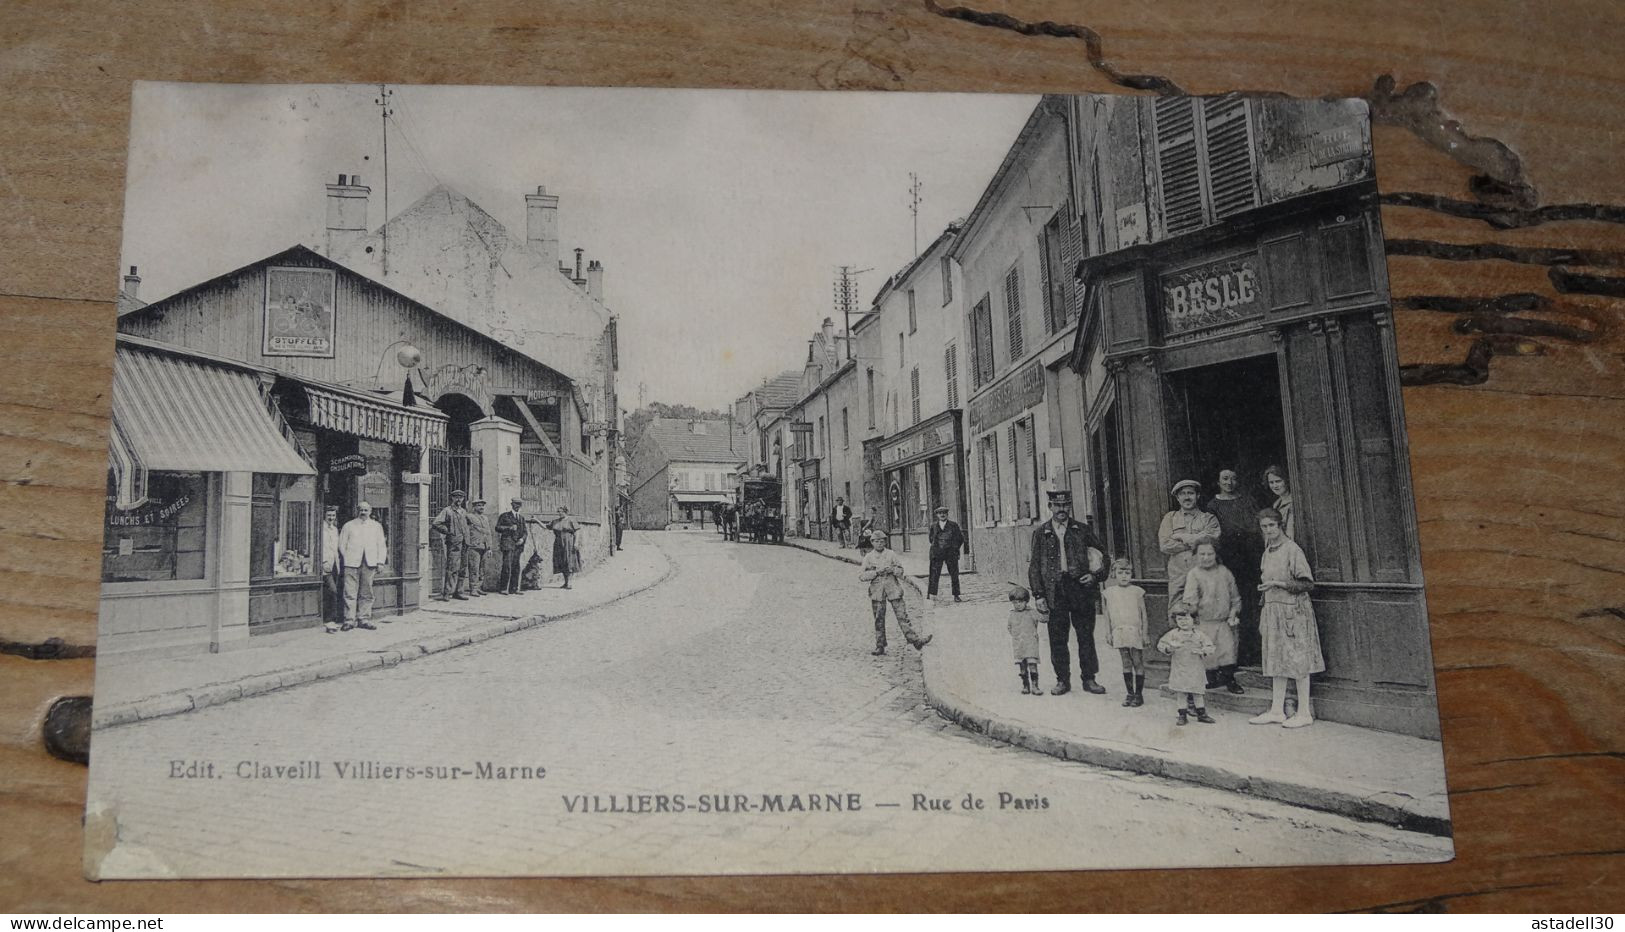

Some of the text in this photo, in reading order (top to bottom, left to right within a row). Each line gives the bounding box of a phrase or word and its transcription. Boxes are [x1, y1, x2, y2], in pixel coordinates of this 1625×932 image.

[110, 514, 140, 526] LUNCHS
[144, 512, 155, 524] ET
[168, 760, 547, 780] Edit. Claveill Villiers-sur-Marne
[561, 791, 1050, 813] VILLIERS-SUR-MARNE Rue de Paris
